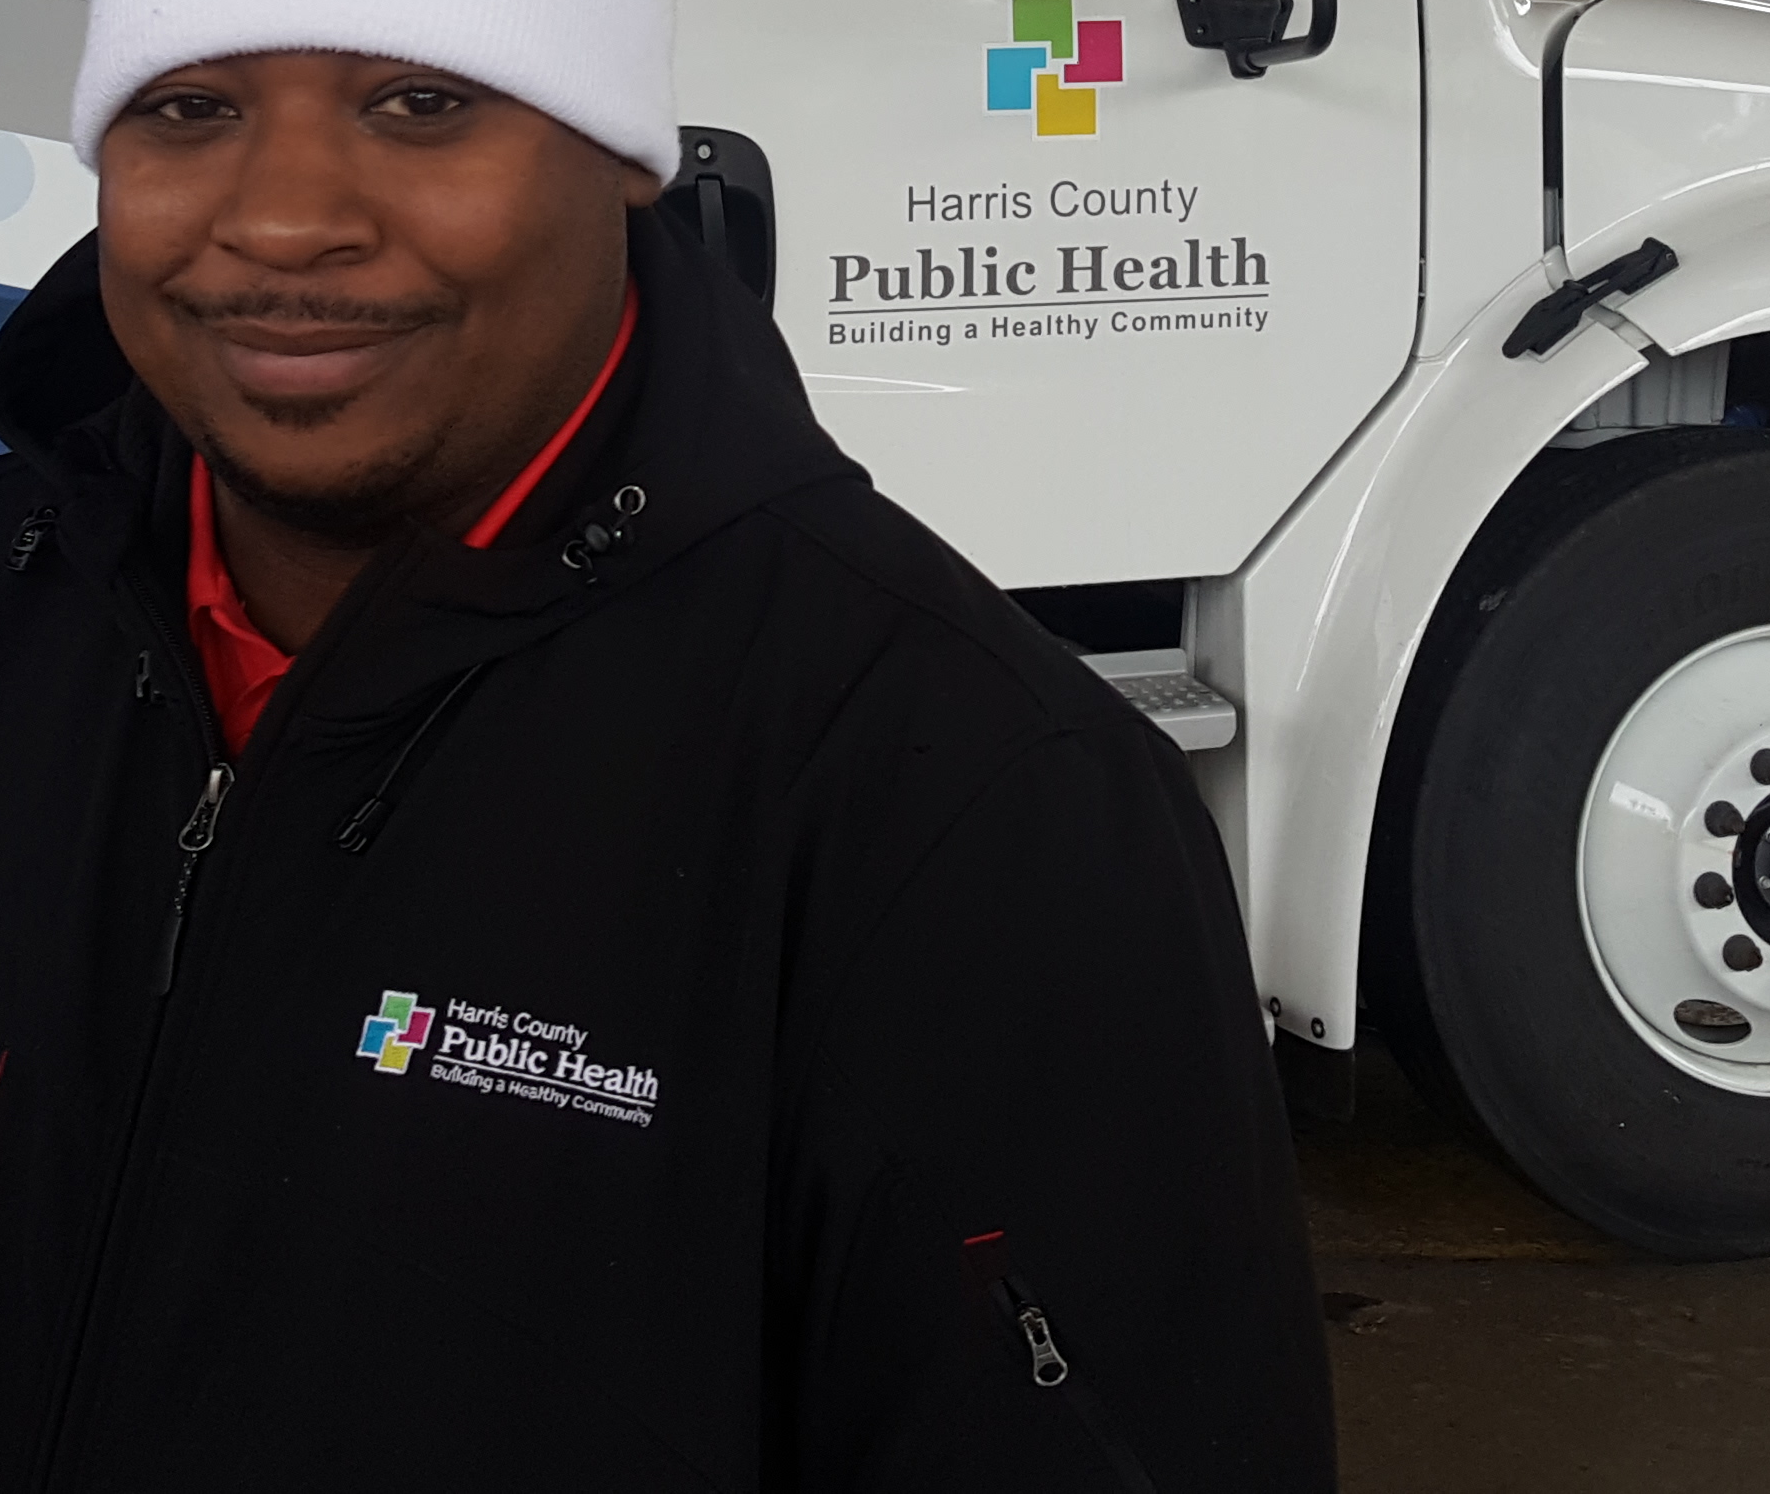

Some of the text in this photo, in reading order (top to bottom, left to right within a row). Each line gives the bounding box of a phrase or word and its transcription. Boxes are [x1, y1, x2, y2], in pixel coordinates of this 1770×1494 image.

[907, 179, 1199, 223] Harris County
[829, 237, 1270, 303] Public Health
[828, 307, 1269, 347] Building a Healthy Community
[447, 998, 588, 1050] Harris County
[440, 1024, 659, 1101] Public Health
[430, 1063, 654, 1128] Building a Healthy Community
